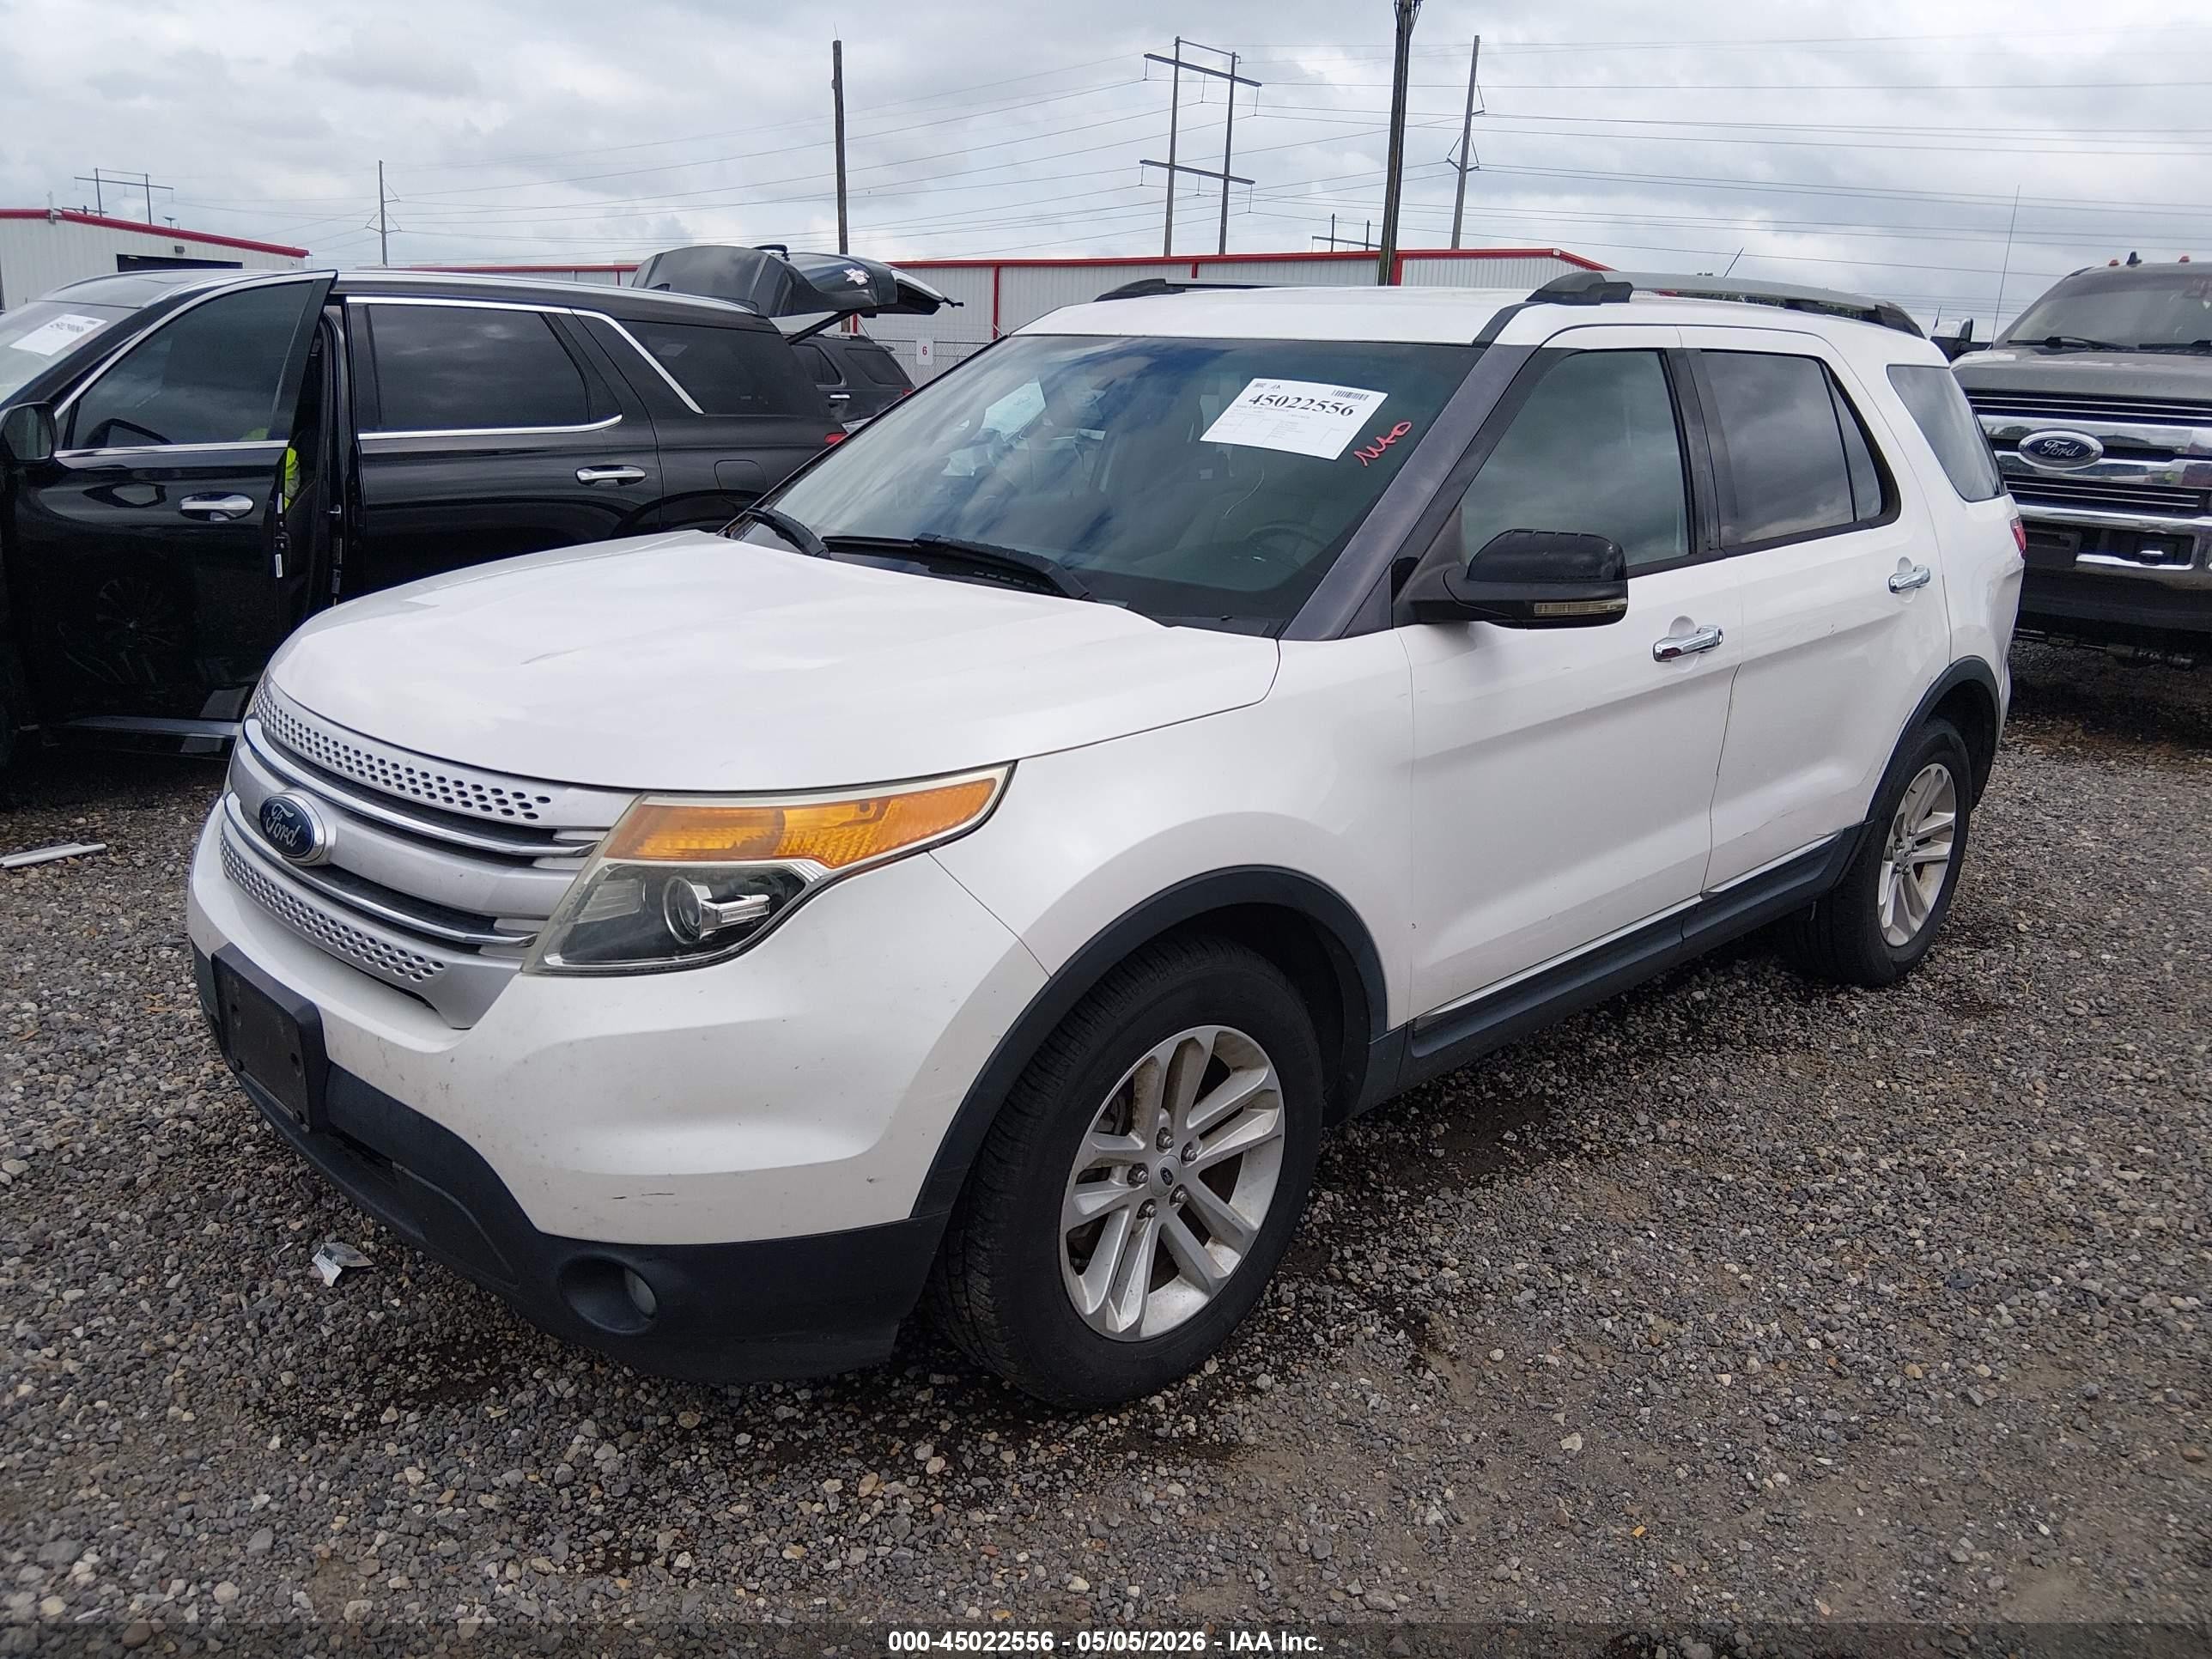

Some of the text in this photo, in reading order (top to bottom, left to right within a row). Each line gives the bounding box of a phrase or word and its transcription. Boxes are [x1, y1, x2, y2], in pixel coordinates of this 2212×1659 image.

[921, 345, 928, 356] 6
[1248, 393, 1359, 417] 45022556
[2039, 439, 2080, 457] Ford
[265, 803, 301, 848] Ford
